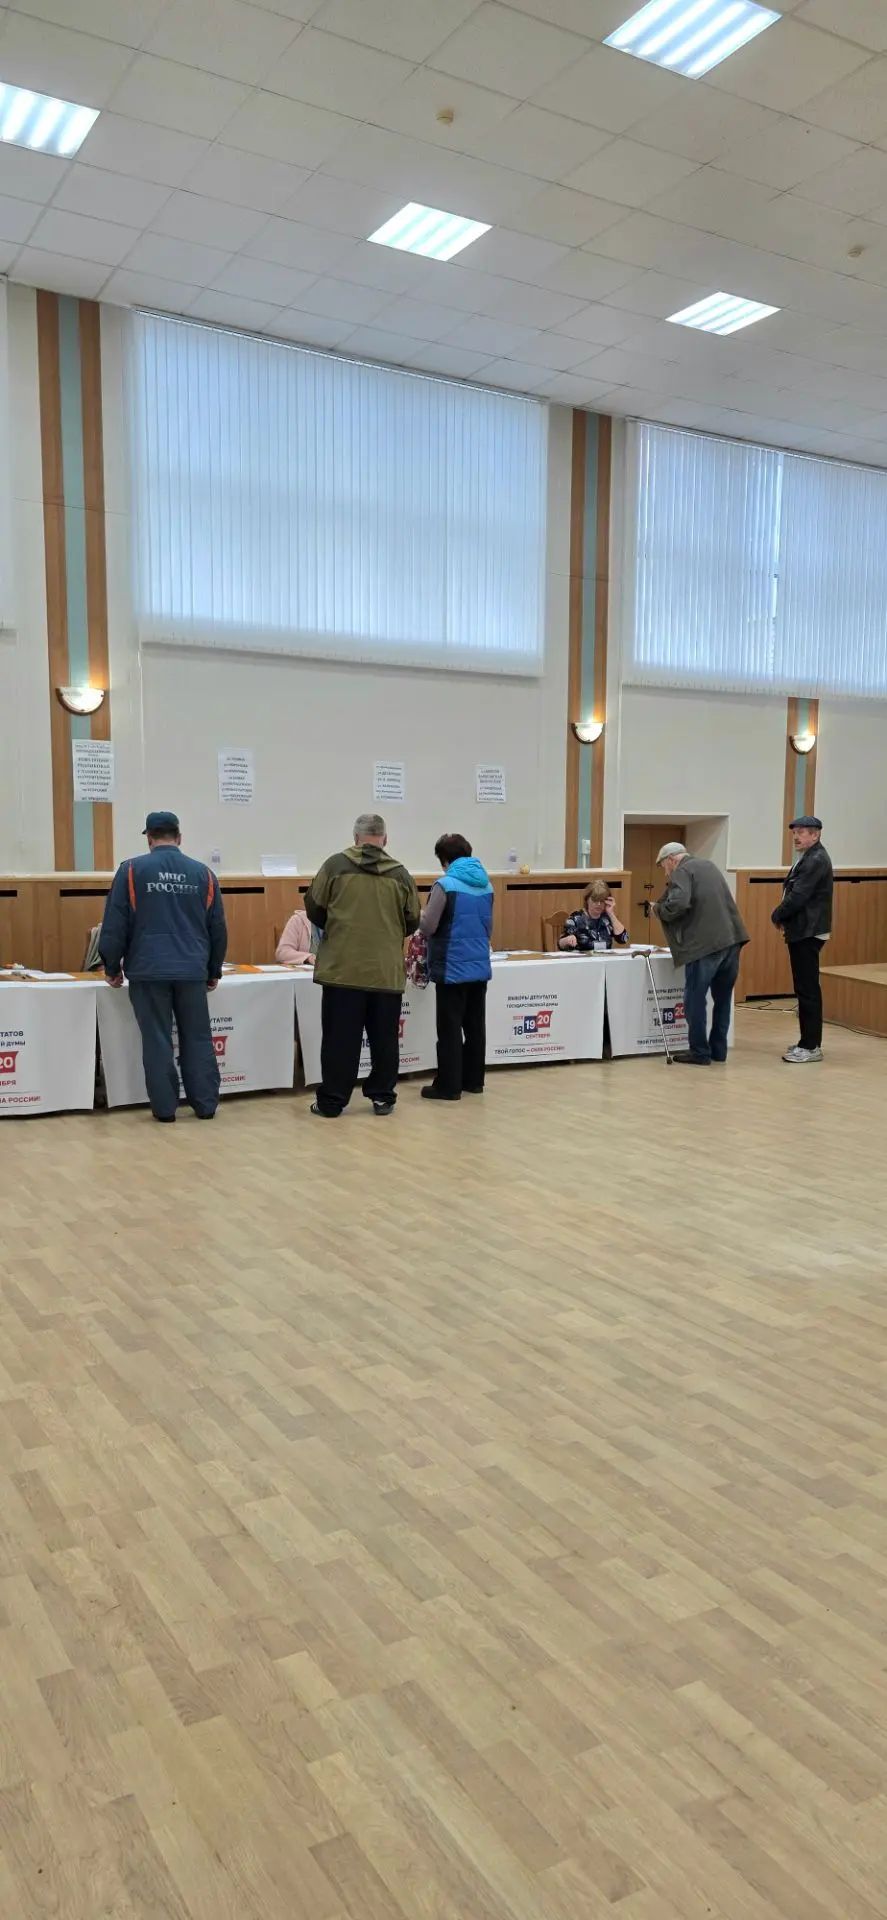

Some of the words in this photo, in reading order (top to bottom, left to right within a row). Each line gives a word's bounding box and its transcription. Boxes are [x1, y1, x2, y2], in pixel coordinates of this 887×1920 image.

[158, 871, 186, 883] МЧС
[146, 882, 199, 894] РОССИИ
[663, 1011, 674, 1022] 19
[513, 1025, 524, 1036] 18
[525, 1020, 536, 1030] 19
[537, 1014, 550, 1025] 20
[0, 1030, 24, 1038] ТАТОВ
[212, 1040, 224, 1052] 0
